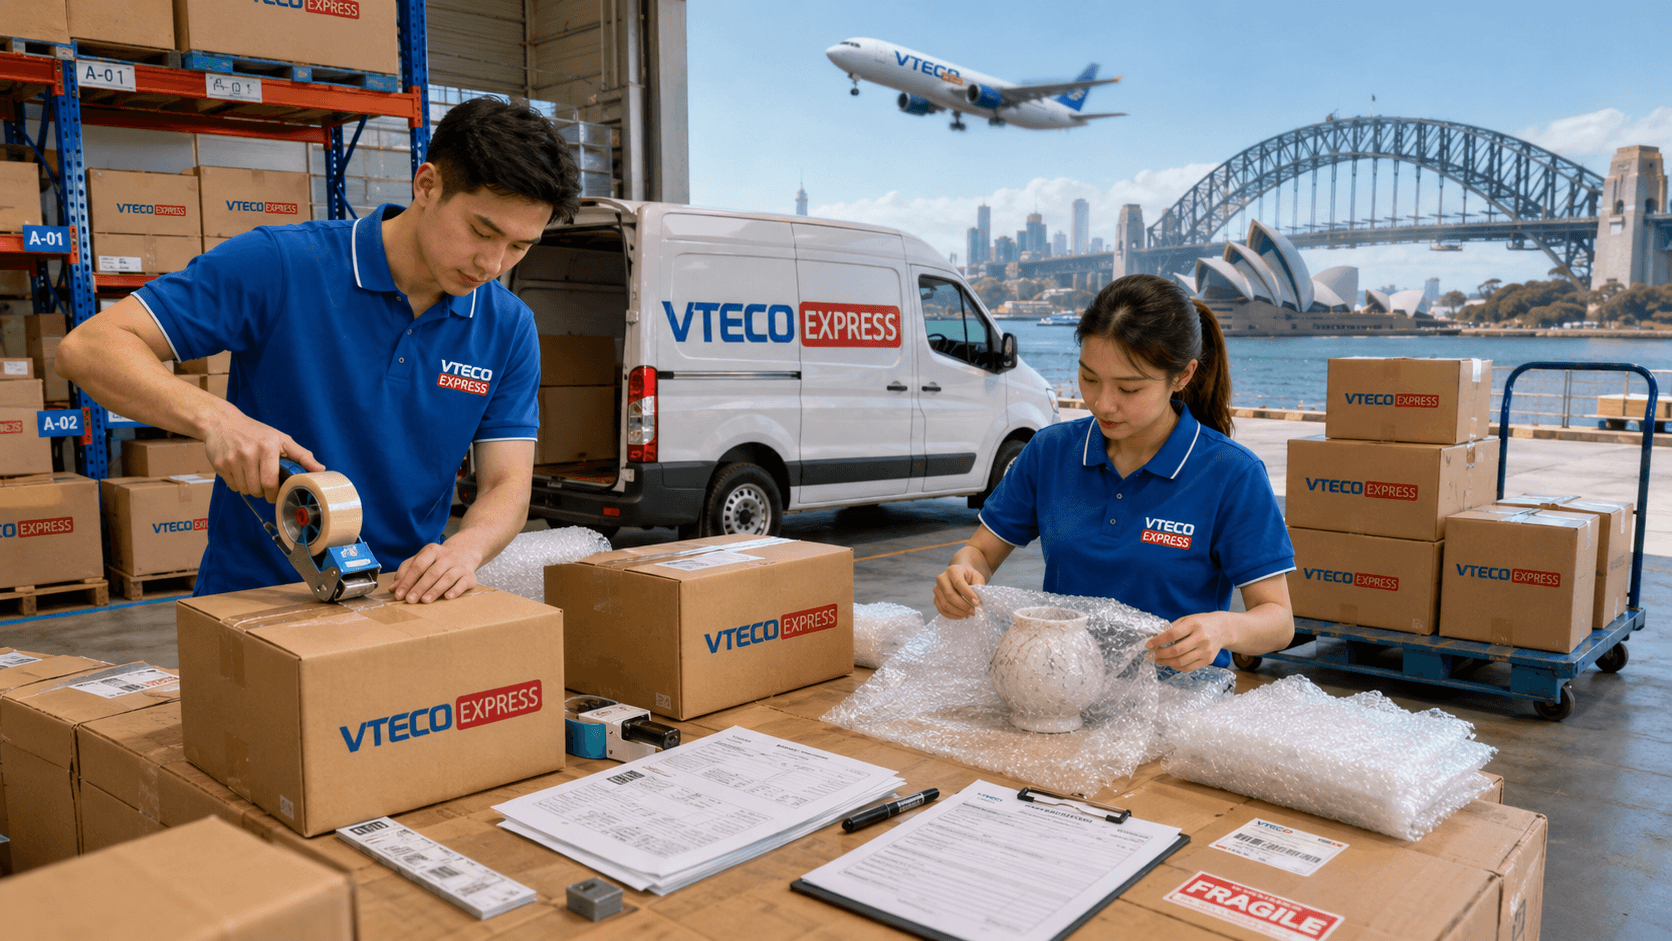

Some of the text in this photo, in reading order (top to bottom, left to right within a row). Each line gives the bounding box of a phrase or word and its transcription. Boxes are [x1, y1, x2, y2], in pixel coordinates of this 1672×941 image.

[307, 0, 359, 17] EXPRESS
[85, 65, 124, 84] A-01
[116, 203, 154, 214] VTECO
[225, 200, 264, 212] VTECO
[29, 230, 63, 246] A-01
[661, 301, 897, 343] VTECO EXPRESS
[441, 359, 493, 382] VTECO
[439, 374, 488, 394] EXPRESS
[1345, 393, 1438, 407] VTECO EXPRESS
[43, 415, 78, 431] A-02
[1305, 477, 1416, 499] VTECO EXPRESS
[20, 519, 72, 536] EXPRESS
[152, 520, 193, 534] VTECO
[1145, 517, 1195, 536] VTECO
[1142, 531, 1190, 548] EXPRESS
[1303, 567, 1398, 590] VTECO EXPRESS
[1456, 563, 1559, 586] VTECO EXPRESS
[704, 608, 836, 654] VTECO EXPRESS
[339, 686, 540, 753] VTECO EXPRESS
[1185, 879, 1329, 937] FRAGILE
